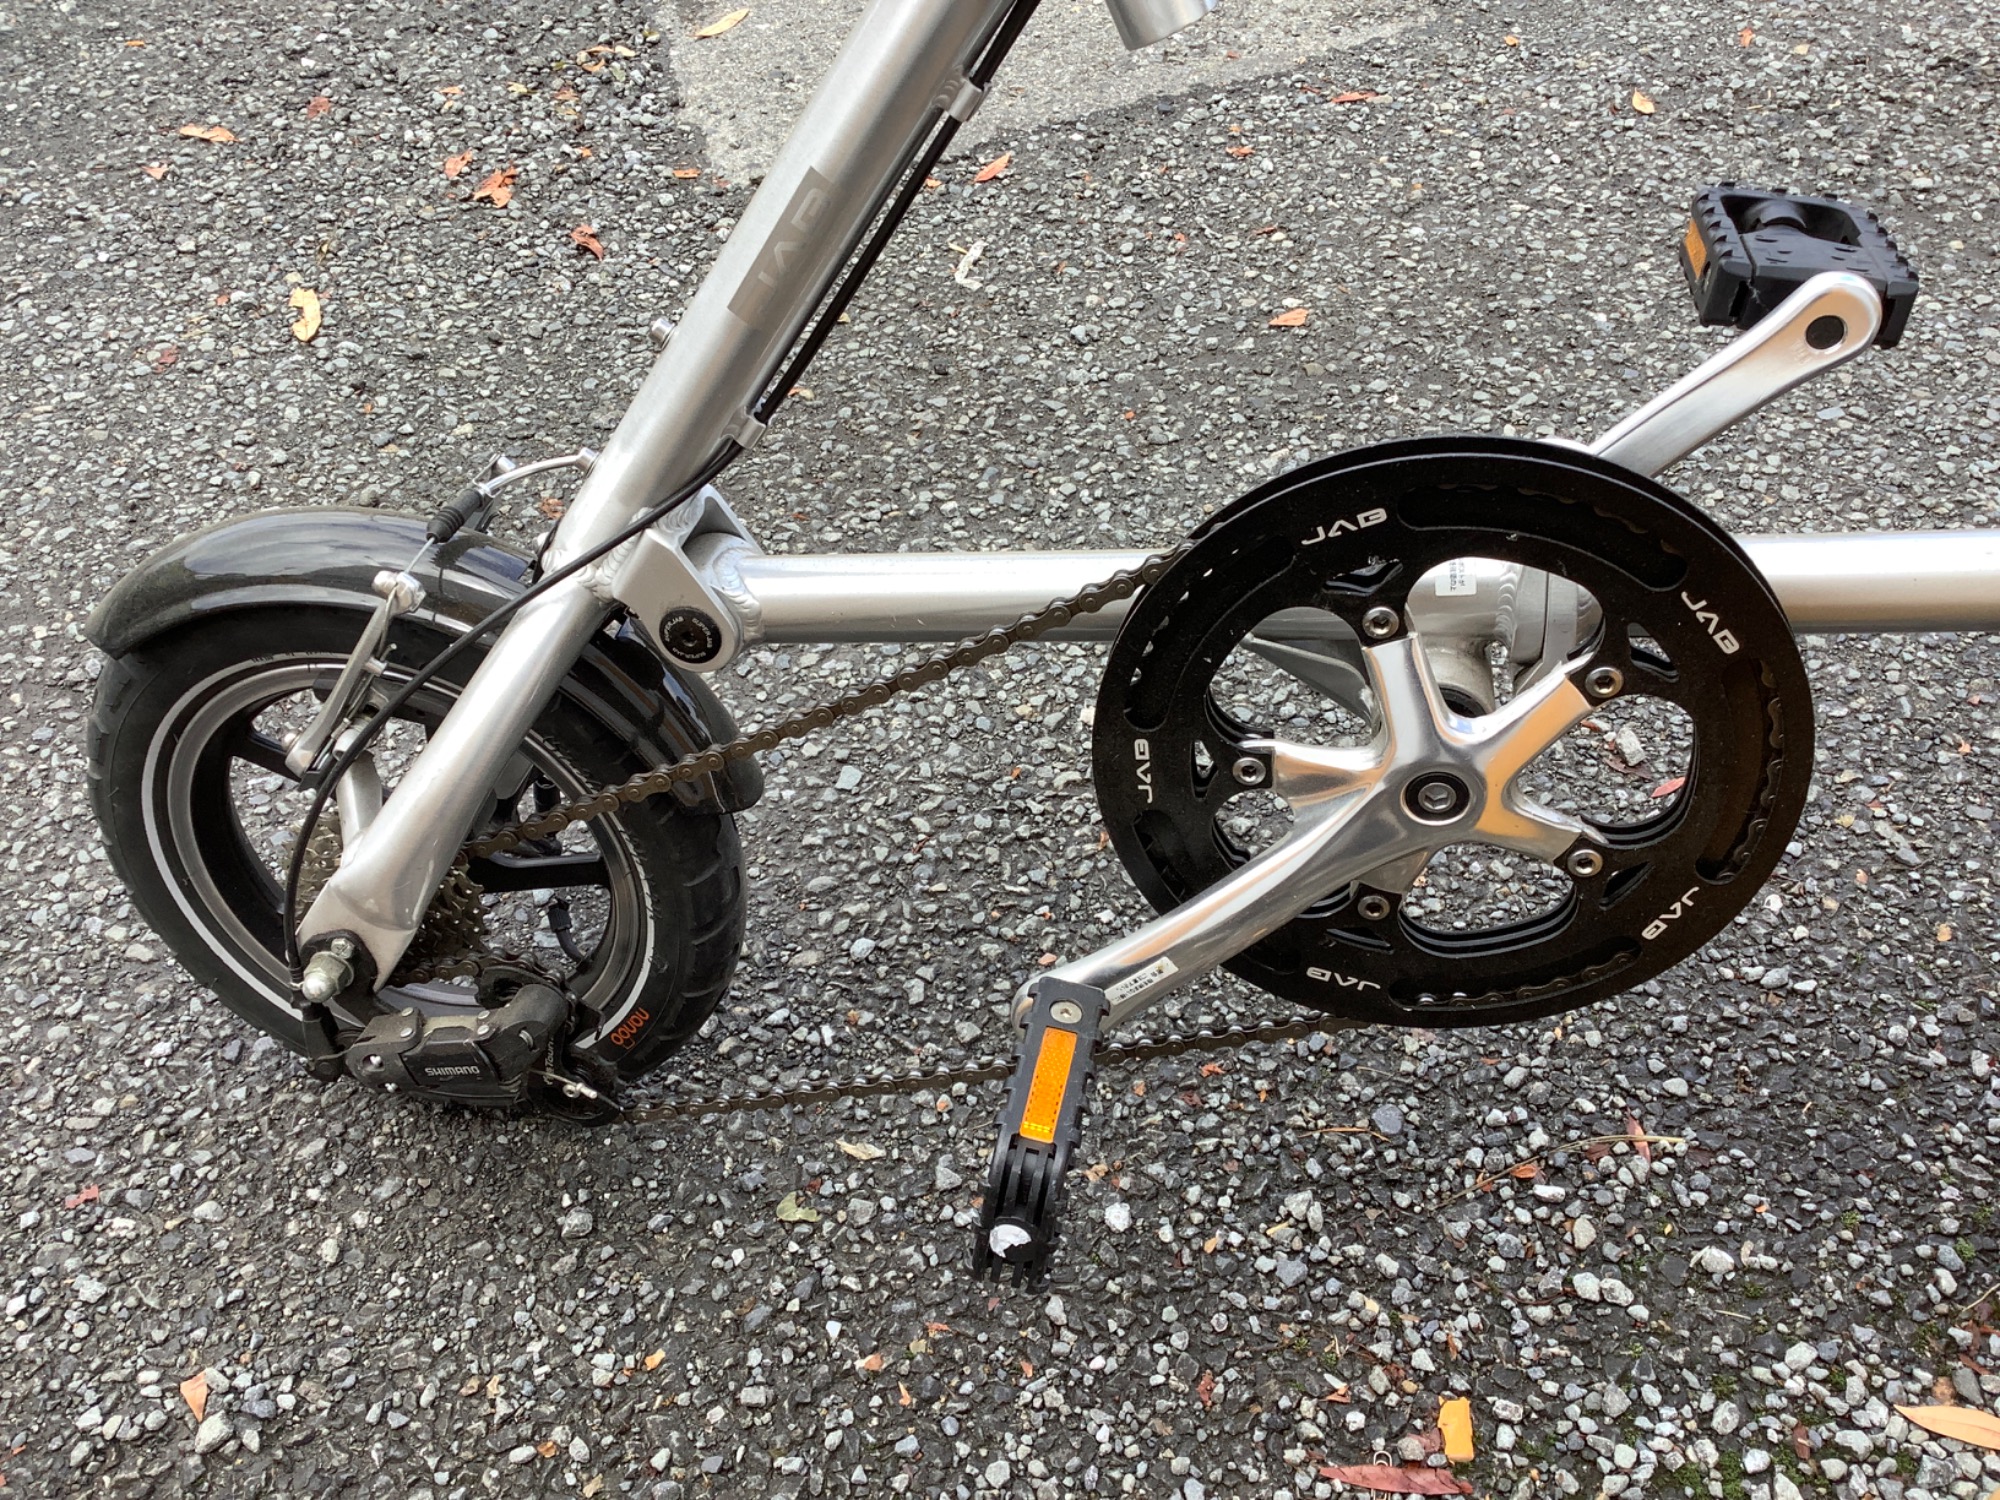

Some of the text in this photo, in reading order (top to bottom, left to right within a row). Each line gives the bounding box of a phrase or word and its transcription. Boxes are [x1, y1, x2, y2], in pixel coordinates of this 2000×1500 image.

[1301, 508, 1387, 545] JAB
[1681, 591, 1740, 654] JAB
[1134, 738, 1153, 804] JAB
[1641, 886, 1700, 940] JAB
[1306, 966, 1381, 992] JAB
[424, 1065, 481, 1077] SHIMANO
